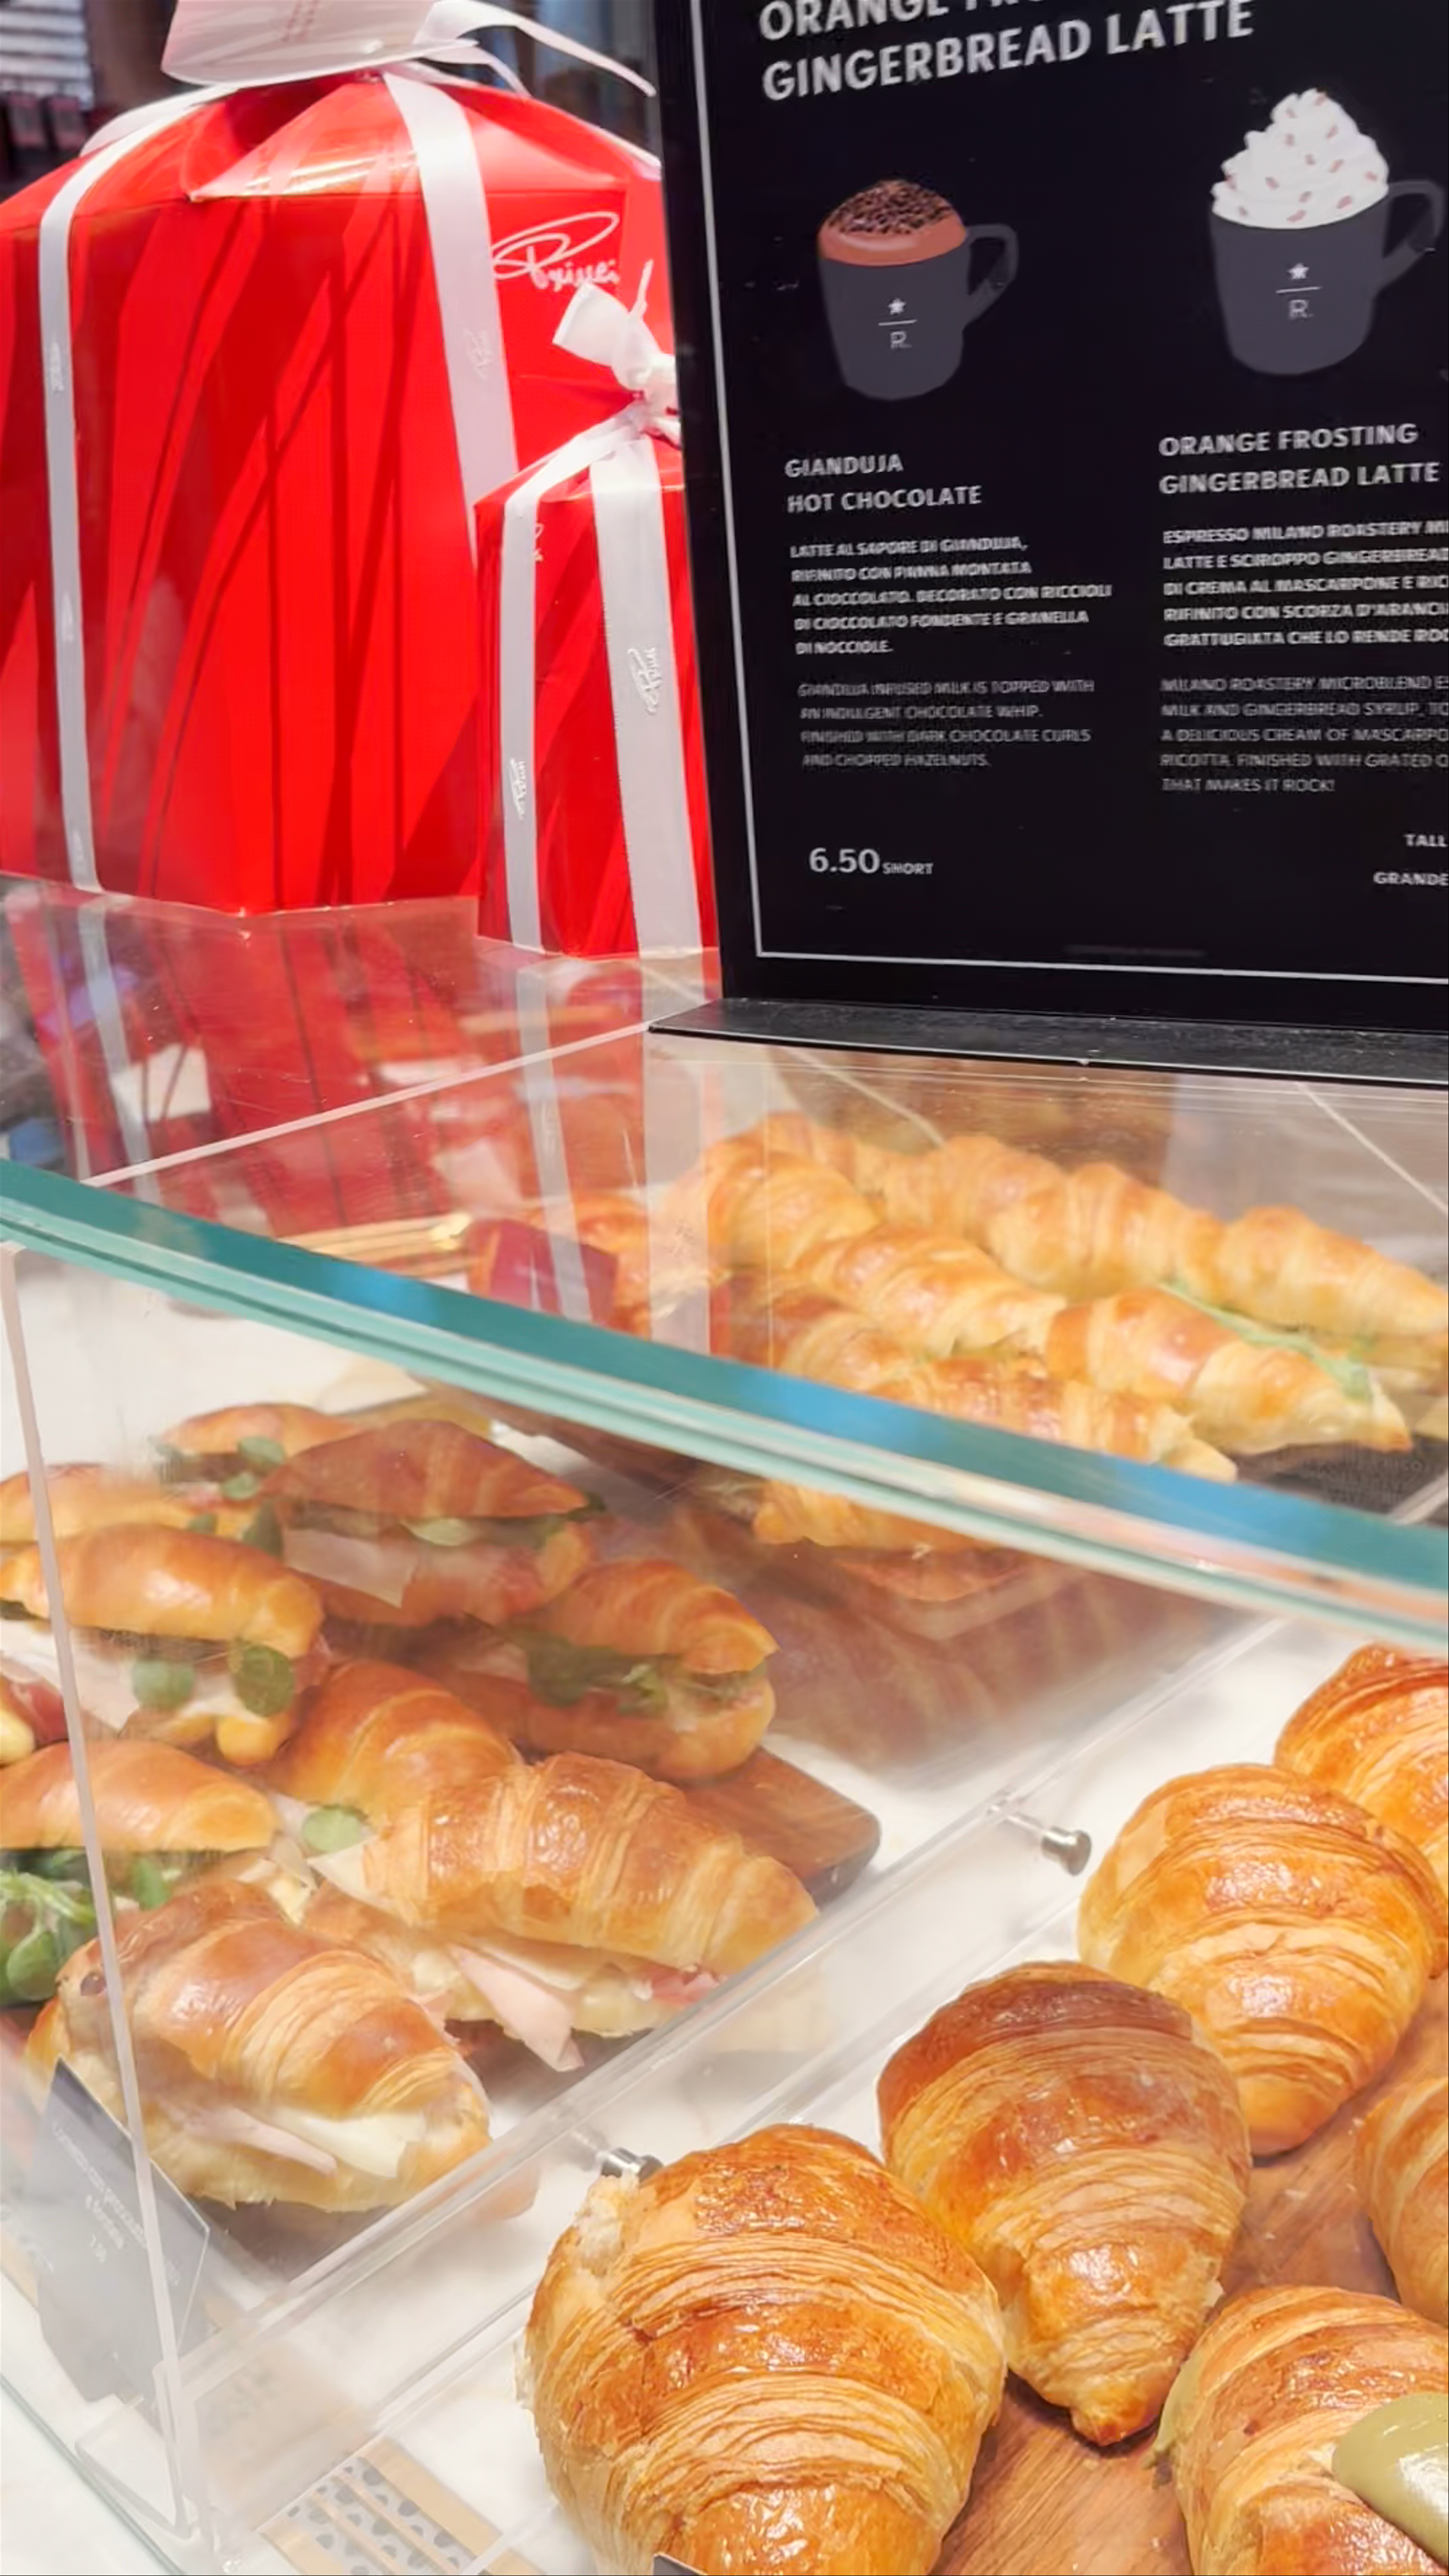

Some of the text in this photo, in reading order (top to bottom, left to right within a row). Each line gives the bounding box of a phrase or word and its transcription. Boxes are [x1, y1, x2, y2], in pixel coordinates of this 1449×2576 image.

[760, 0, 1254, 101] GINGERBREAD LATTE
[1158, 423, 1418, 457] ORANGE FROSTING
[784, 454, 904, 478] GIANDUJA
[1158, 461, 1440, 495] GINGERBREAD LATTE
[787, 484, 982, 513] HOT CHOCOLATE
[790, 543, 835, 558] LATTE
[1163, 555, 1214, 570] LATTE
[1216, 554, 1228, 569] E
[857, 566, 892, 581] CON
[1002, 586, 1039, 600] CON
[1163, 582, 1183, 596] DI
[1401, 575, 1415, 590] E
[992, 612, 1005, 626] E
[1240, 605, 1280, 620] CON
[1286, 630, 1323, 645] CHE
[1324, 630, 1350, 644] LO
[1404, 833, 1448, 848] TALL
[809, 847, 934, 875] 6.50 SHORT
[1373, 871, 1449, 886] GRANDE
